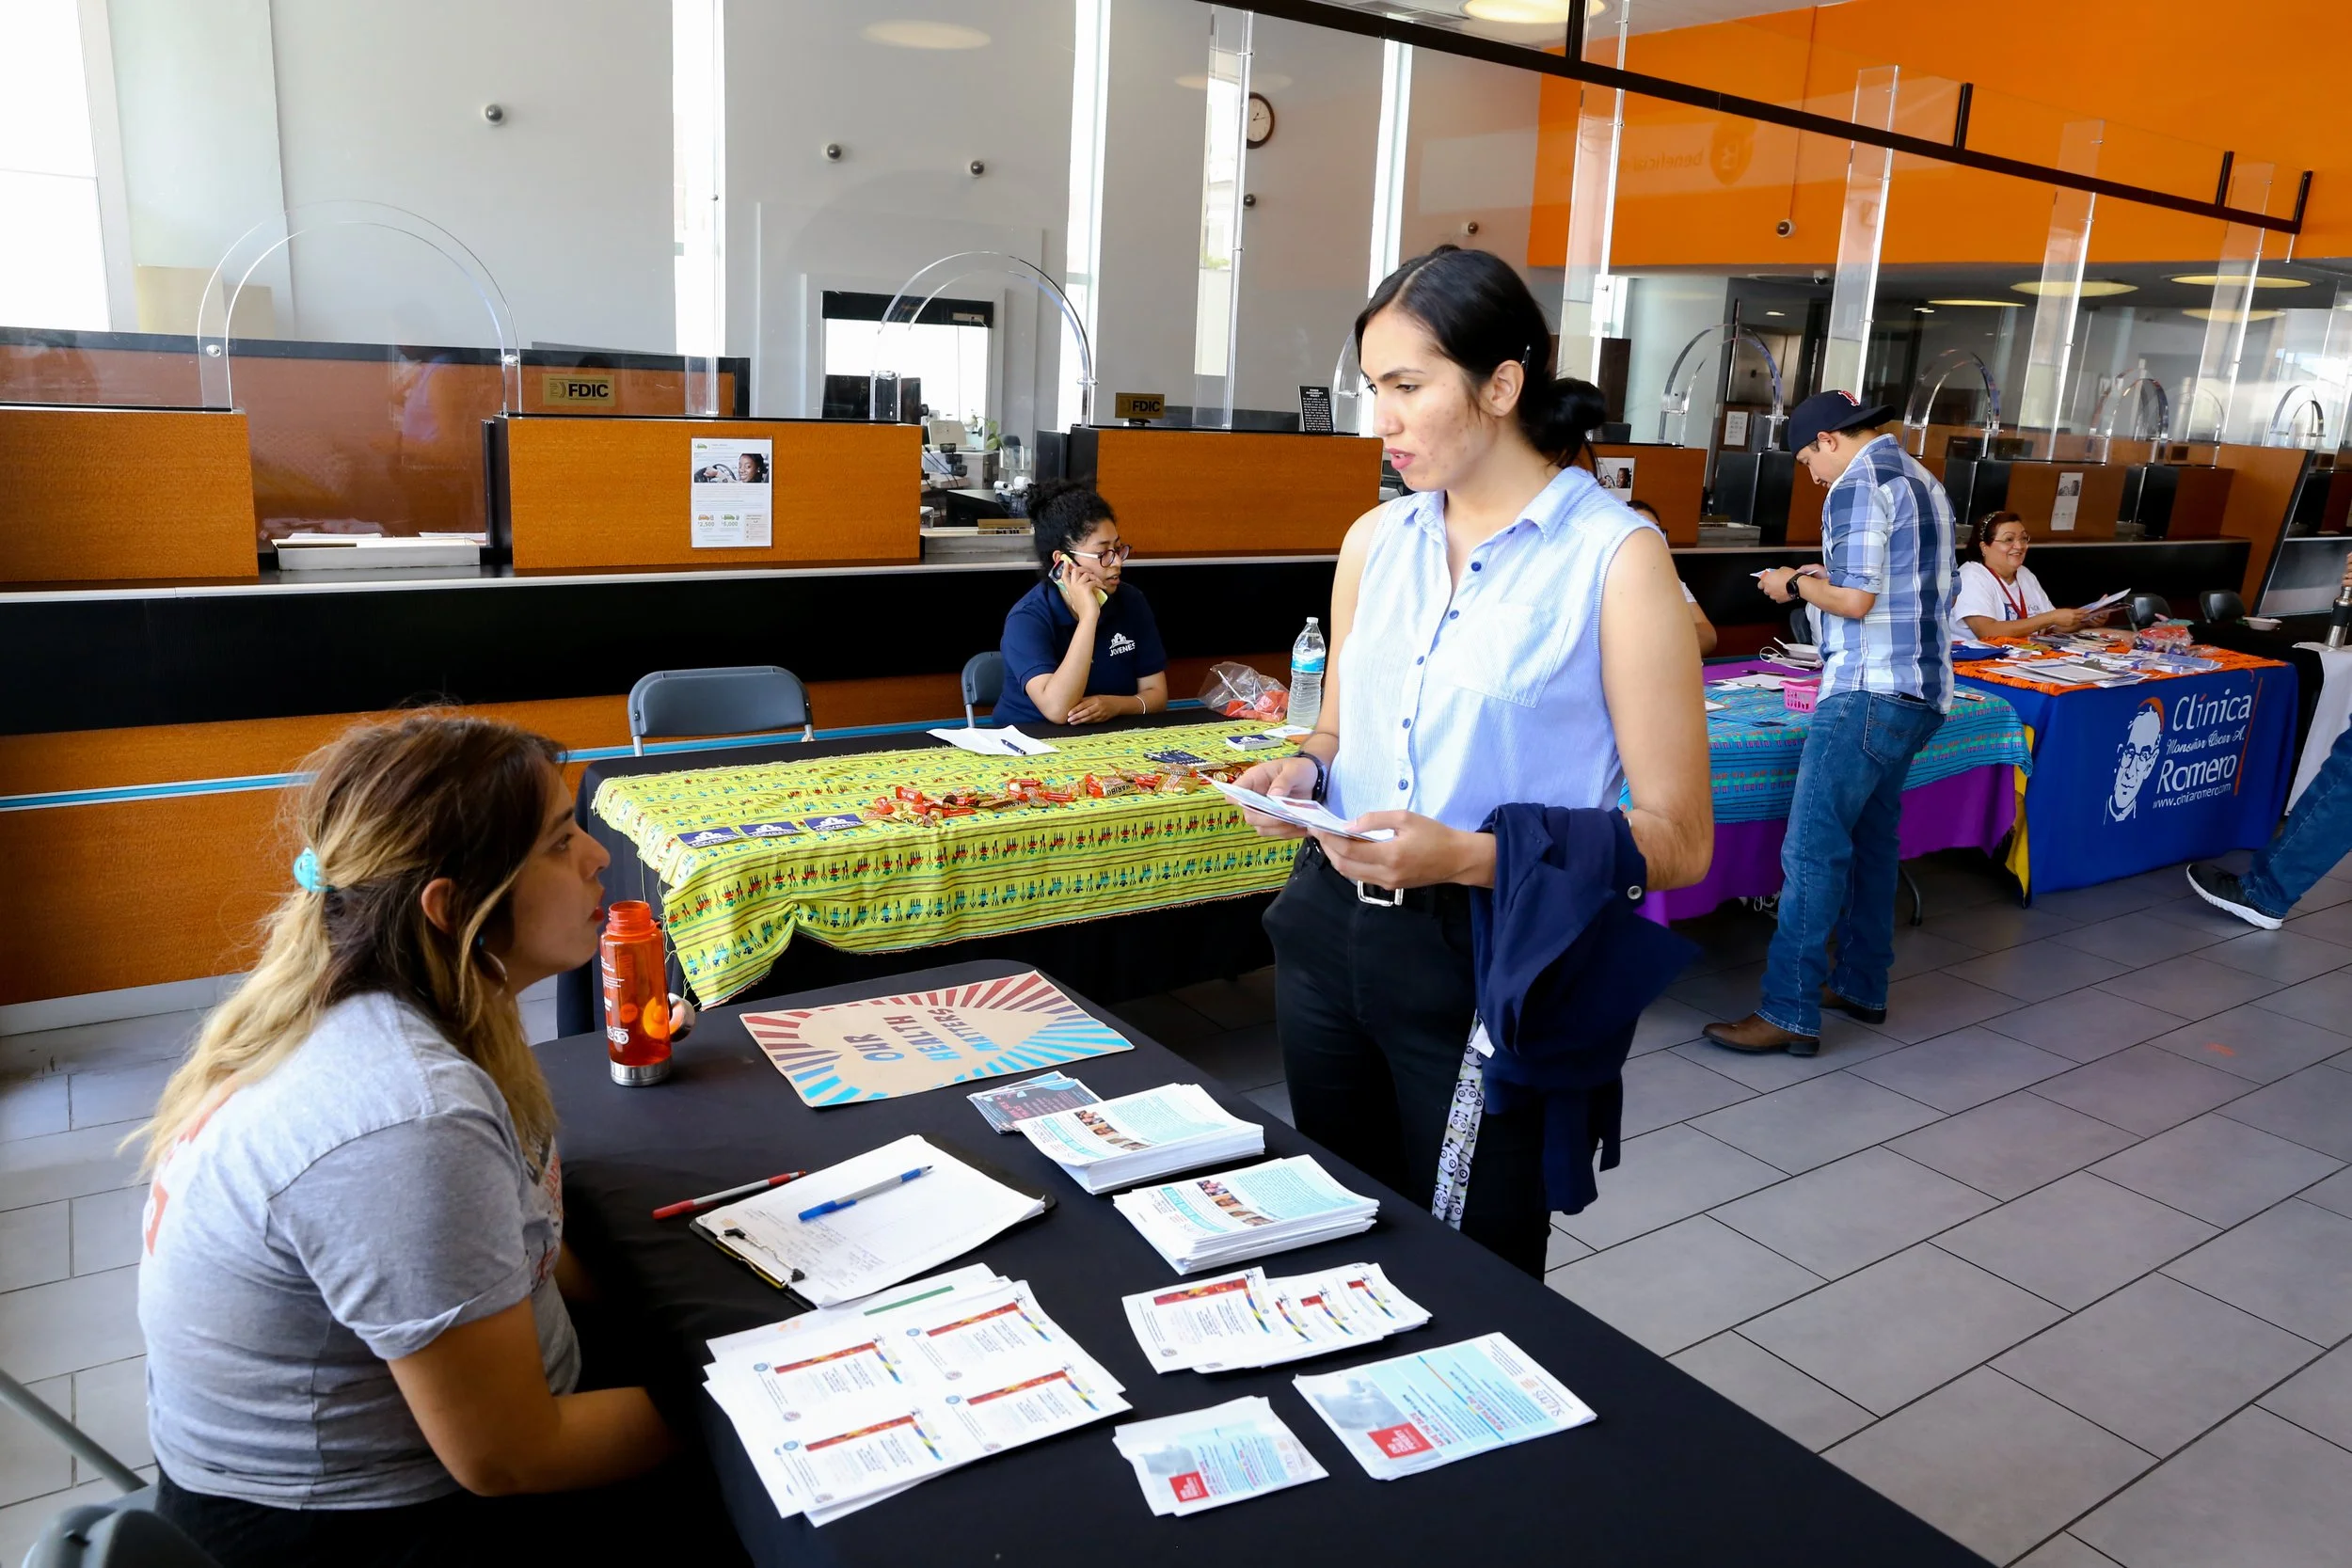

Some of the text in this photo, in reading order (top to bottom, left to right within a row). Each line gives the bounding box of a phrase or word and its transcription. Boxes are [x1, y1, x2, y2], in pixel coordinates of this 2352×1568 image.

[568, 383, 610, 398] FDIC
[1132, 400, 1161, 413] FDIC
[1110, 641, 1136, 657] JOVENES
[2172, 688, 2252, 733] Clínica
[2155, 754, 2237, 795] Romero
[1106, 784, 1131, 797] HARIBO
[882, 1015, 962, 1062] HEALTH
[927, 1008, 1003, 1053] MATTERS
[843, 1033, 905, 1062] OUR
